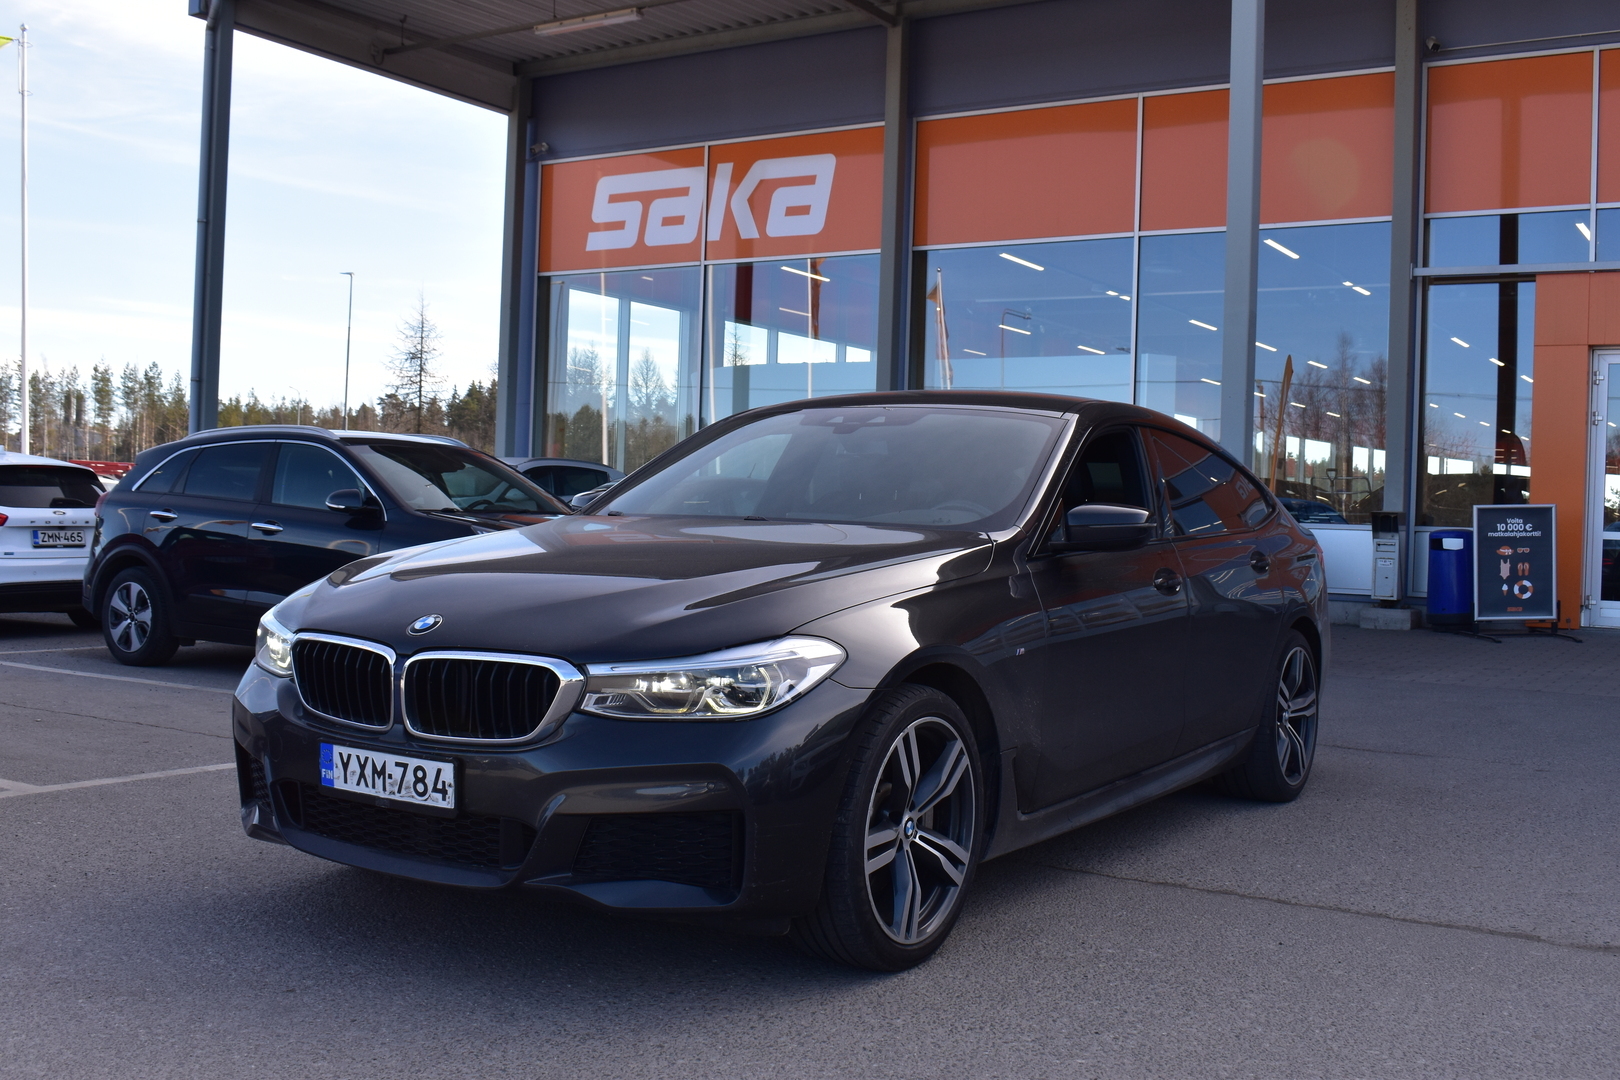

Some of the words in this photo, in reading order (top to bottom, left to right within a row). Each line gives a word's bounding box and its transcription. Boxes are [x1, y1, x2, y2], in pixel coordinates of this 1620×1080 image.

[1496, 523, 1506, 531] 10
[1507, 523, 1524, 531] 000
[1525, 523, 1533, 531] €
[40, 532, 83, 543] ZMN-465
[321, 768, 334, 780] FIN
[338, 751, 449, 802] YXM-784
